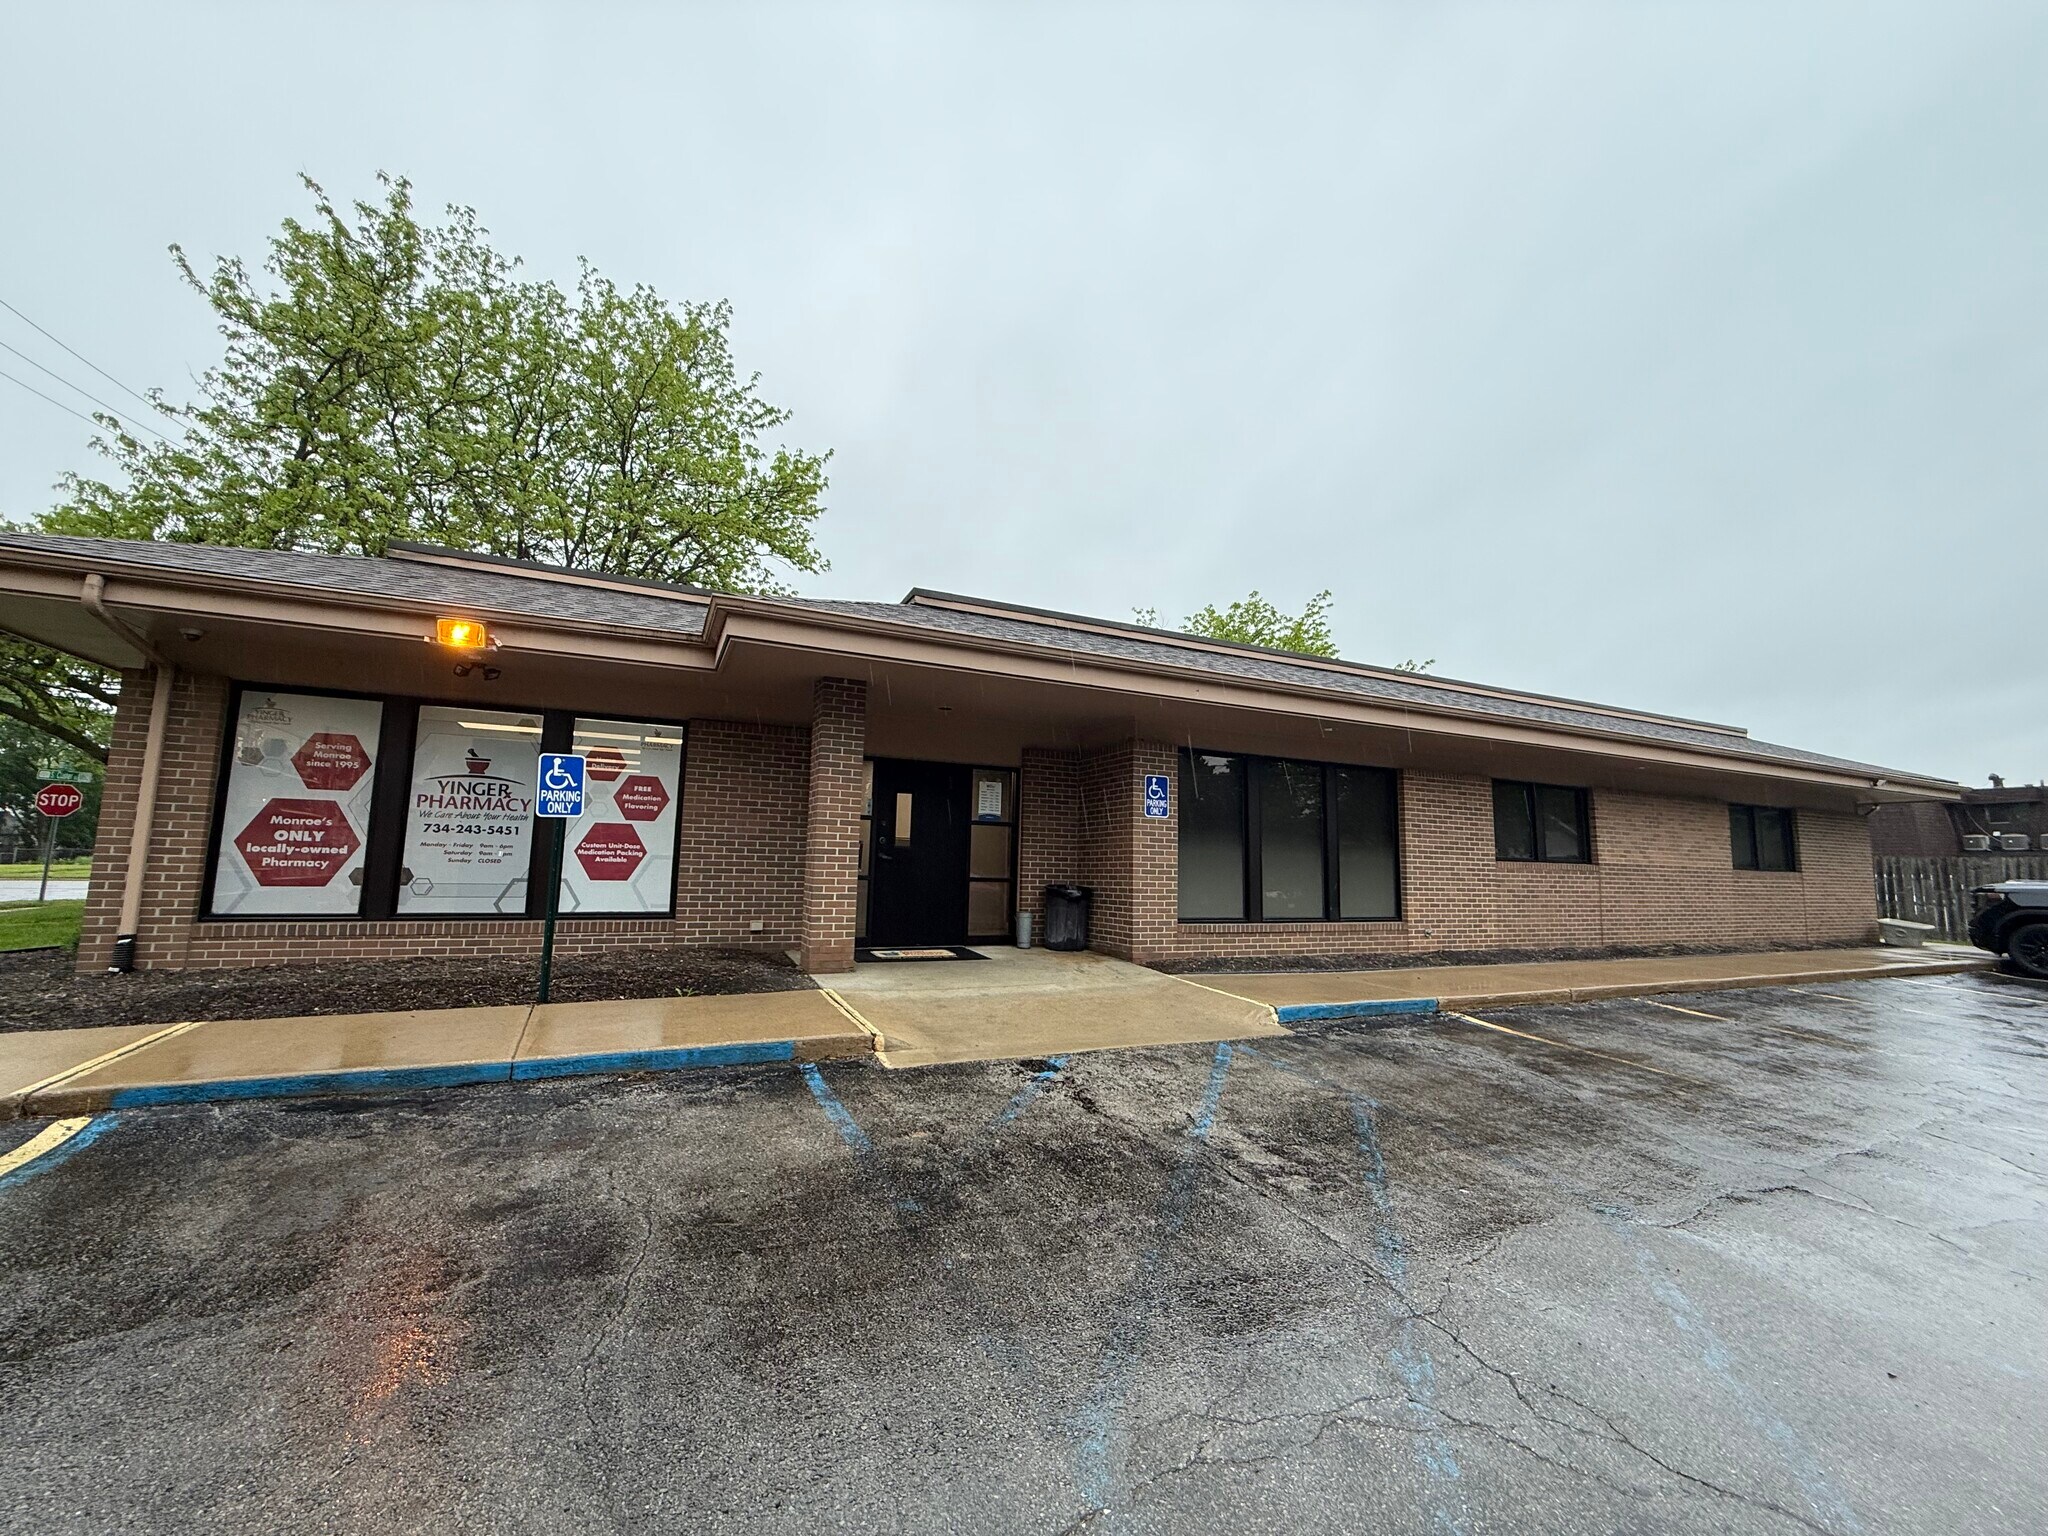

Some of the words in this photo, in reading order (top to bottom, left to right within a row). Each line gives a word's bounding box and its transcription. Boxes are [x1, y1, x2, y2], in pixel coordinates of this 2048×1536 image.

[315, 741, 352, 752] Serving
[313, 751, 352, 760] Monroe
[306, 760, 331, 768] since
[335, 761, 360, 769] 1995
[437, 780, 513, 799] YINGER
[39, 793, 79, 807] STOP
[540, 789, 581, 803] PARKING
[622, 794, 662, 802] Medication
[416, 794, 532, 812] PHARMACY
[547, 802, 574, 814] ONLY
[624, 803, 659, 812] Flavoring
[1147, 799, 1167, 808] PARKING
[419, 810, 433, 818] We
[434, 810, 453, 819] Care
[454, 811, 481, 820] About
[483, 812, 501, 821] Your
[502, 812, 529, 821] Health
[1150, 807, 1164, 815] ONLY
[270, 815, 333, 826] Monroe's
[423, 823, 520, 836] 734-243-5451
[274, 830, 326, 842] ONLY
[246, 843, 348, 855] locally-owned
[608, 842, 641, 850] Unit-Dose
[262, 857, 330, 870] Pharmacy
